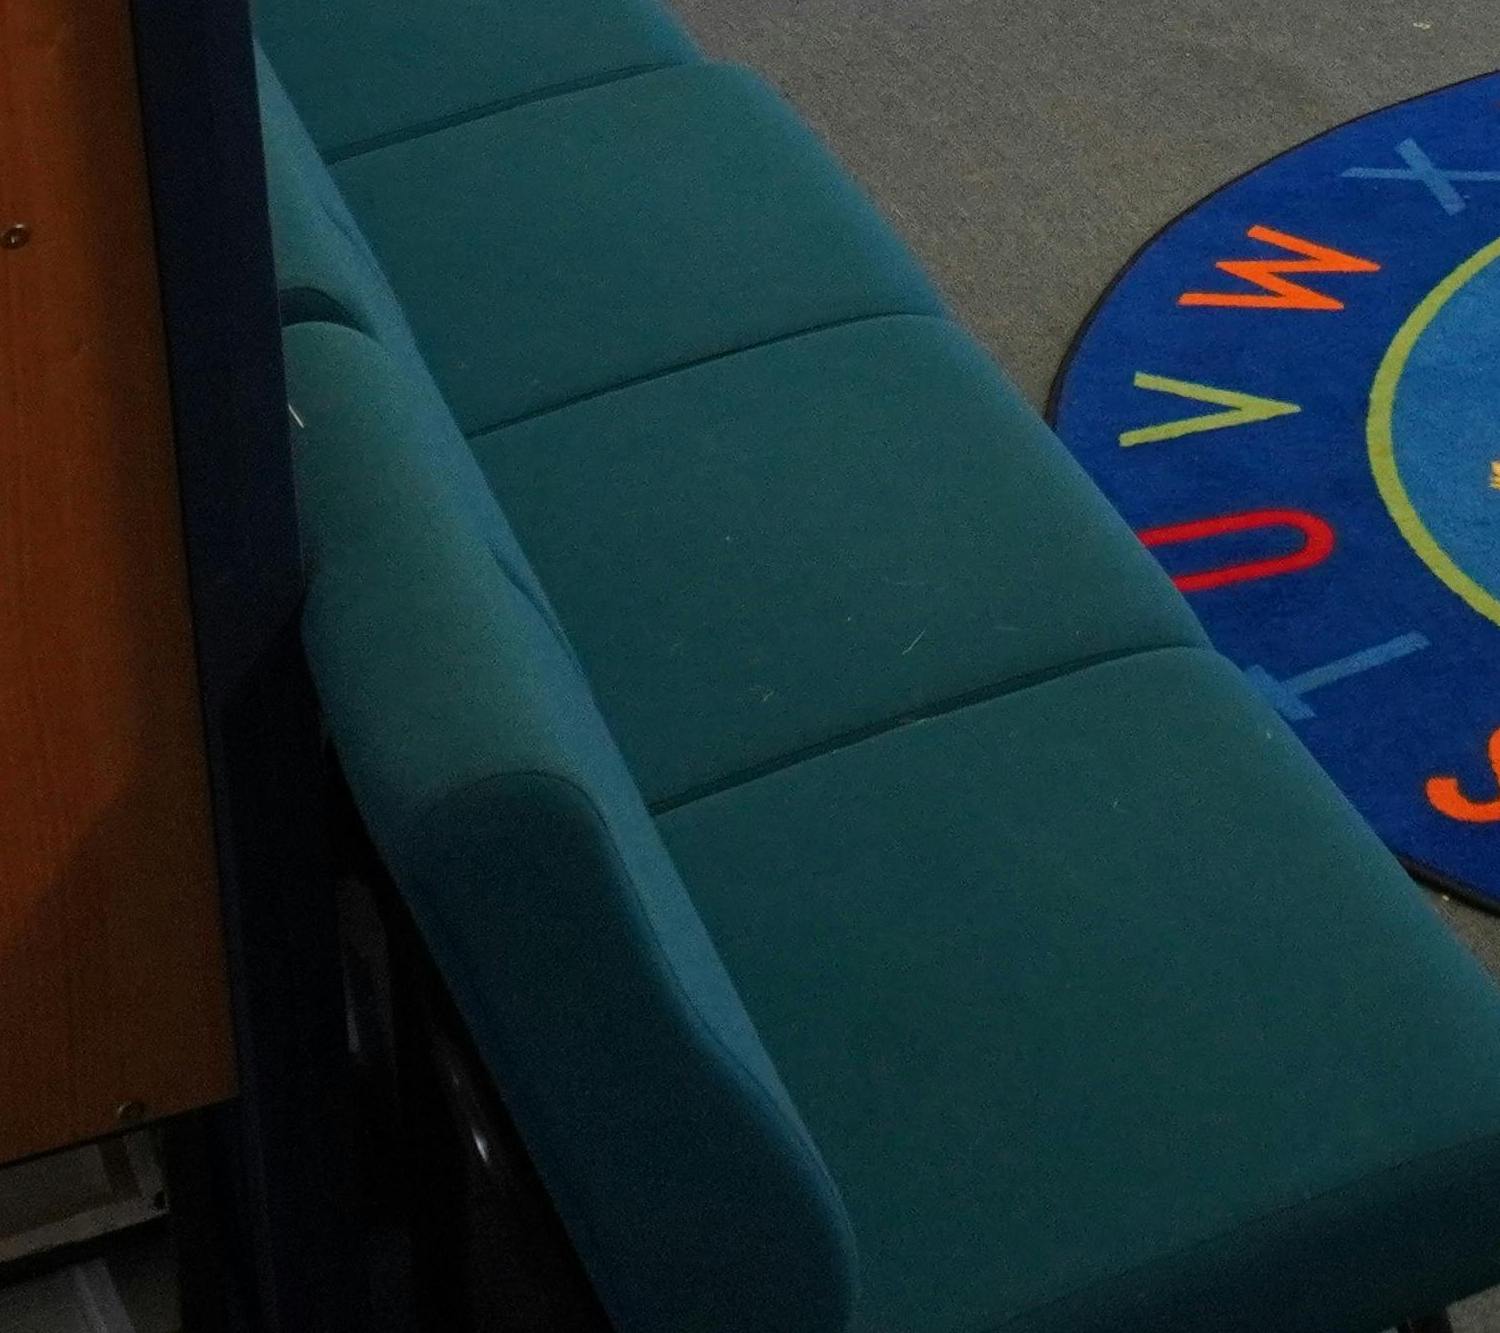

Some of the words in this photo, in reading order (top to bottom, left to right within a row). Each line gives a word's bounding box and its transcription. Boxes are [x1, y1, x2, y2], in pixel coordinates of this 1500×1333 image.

[1179, 225, 1380, 311] W
[1120, 372, 1300, 447] V
[1142, 510, 1334, 592] U
